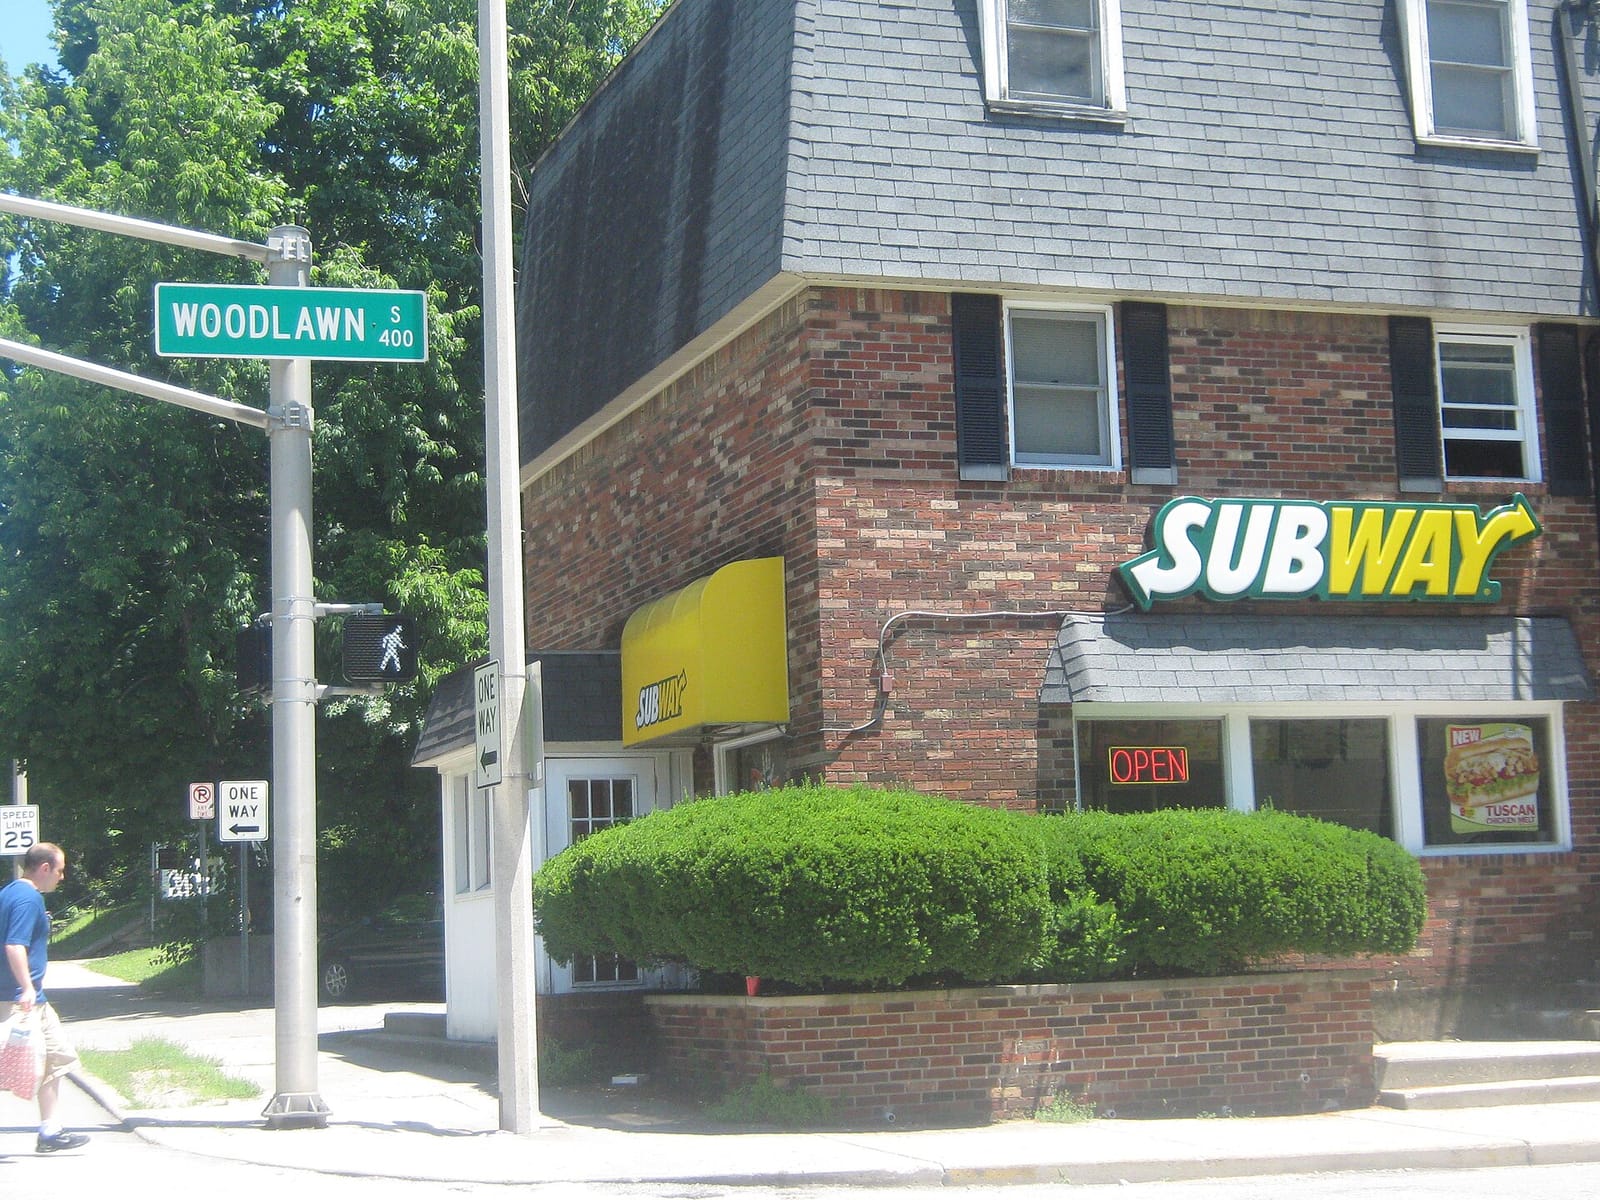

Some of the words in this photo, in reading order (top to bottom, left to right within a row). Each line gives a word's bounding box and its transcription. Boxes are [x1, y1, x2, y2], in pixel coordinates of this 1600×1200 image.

[172, 303, 365, 341] WOODLAWN
[390, 306, 401, 323] S
[378, 329, 414, 347] 400
[1130, 502, 1537, 600] SUBWAY
[478, 673, 495, 703] ONE
[636, 669, 687, 729] SUBWAY
[479, 706, 497, 736] WAY
[1452, 730, 1480, 746] NEW
[1112, 749, 1187, 782] OPEN
[229, 787, 258, 800] ONE
[2, 811, 35, 819] SPEED
[229, 805, 258, 818] WAY
[1485, 804, 1535, 817] TUSCAN
[6, 820, 31, 829] LIMIT
[5, 831, 34, 849] 25
